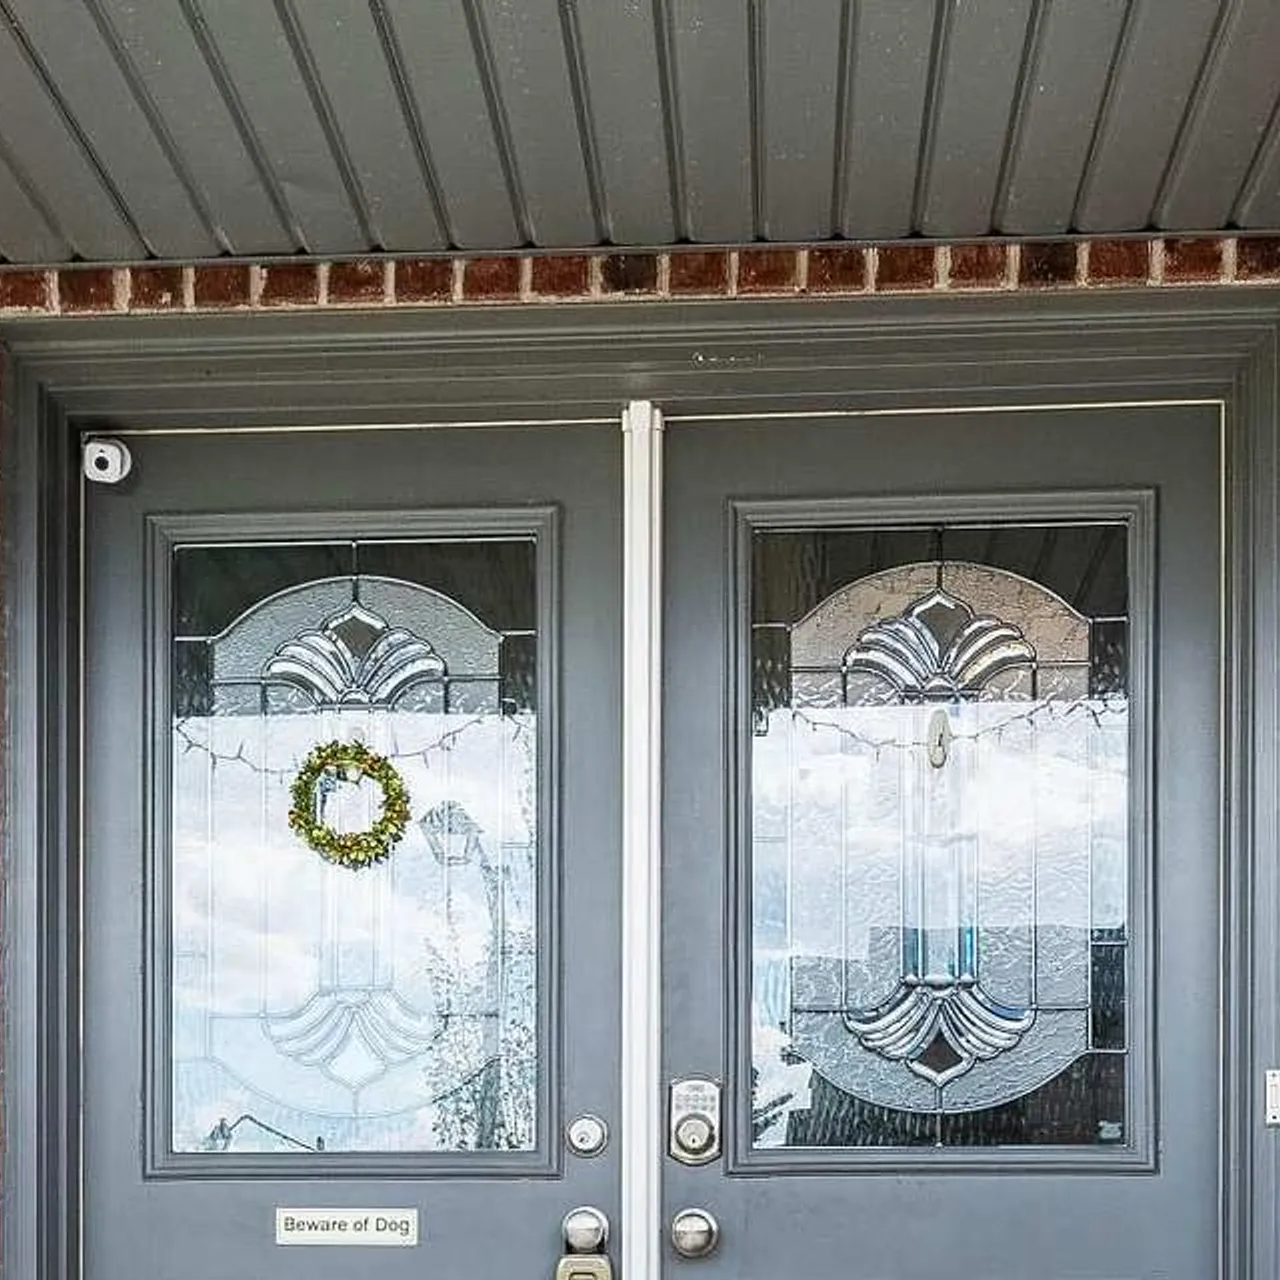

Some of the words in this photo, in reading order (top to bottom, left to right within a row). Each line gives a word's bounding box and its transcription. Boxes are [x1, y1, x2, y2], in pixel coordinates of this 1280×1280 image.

[284, 1216, 348, 1232] Beware
[353, 1217, 369, 1232] of
[375, 1217, 410, 1236] Dog
